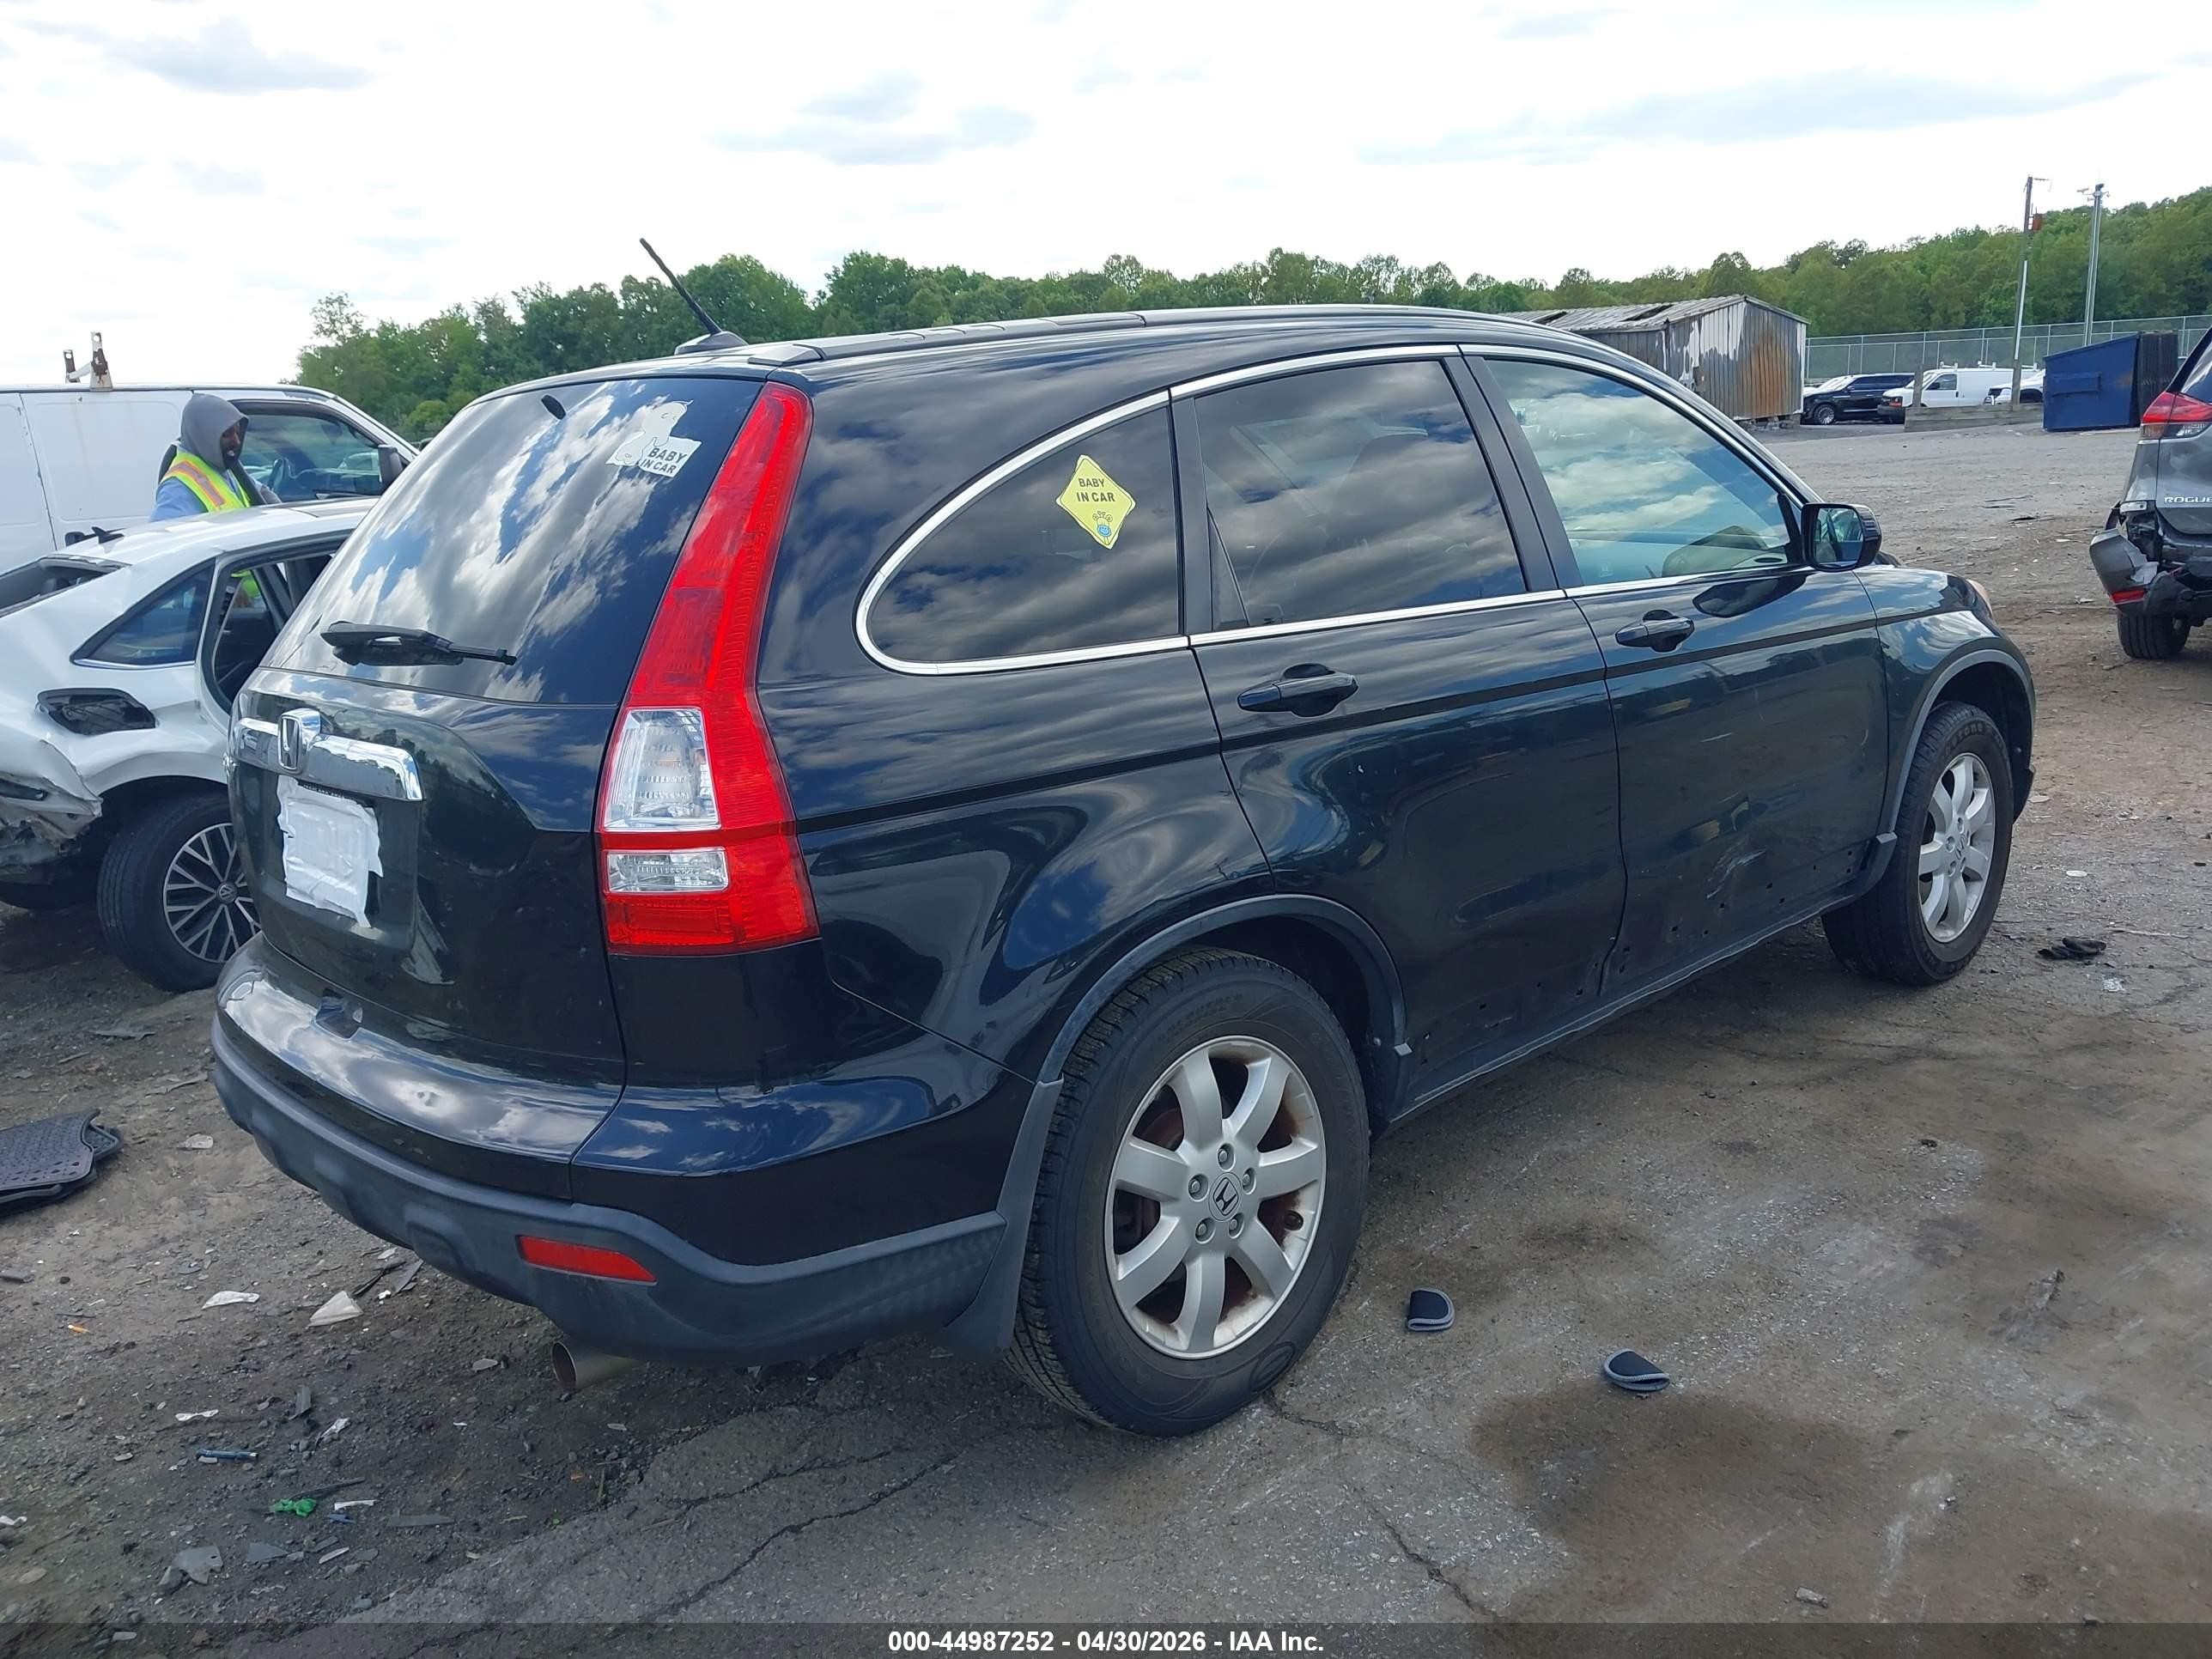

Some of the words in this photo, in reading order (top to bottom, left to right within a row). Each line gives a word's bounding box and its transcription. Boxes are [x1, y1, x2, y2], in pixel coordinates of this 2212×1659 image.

[647, 448, 688, 463] BABY
[639, 458, 652, 469] IN
[653, 461, 678, 474] CAR
[1079, 478, 1105, 488] BABY
[1076, 492, 1090, 501] IN
[1091, 492, 1115, 501] CAR
